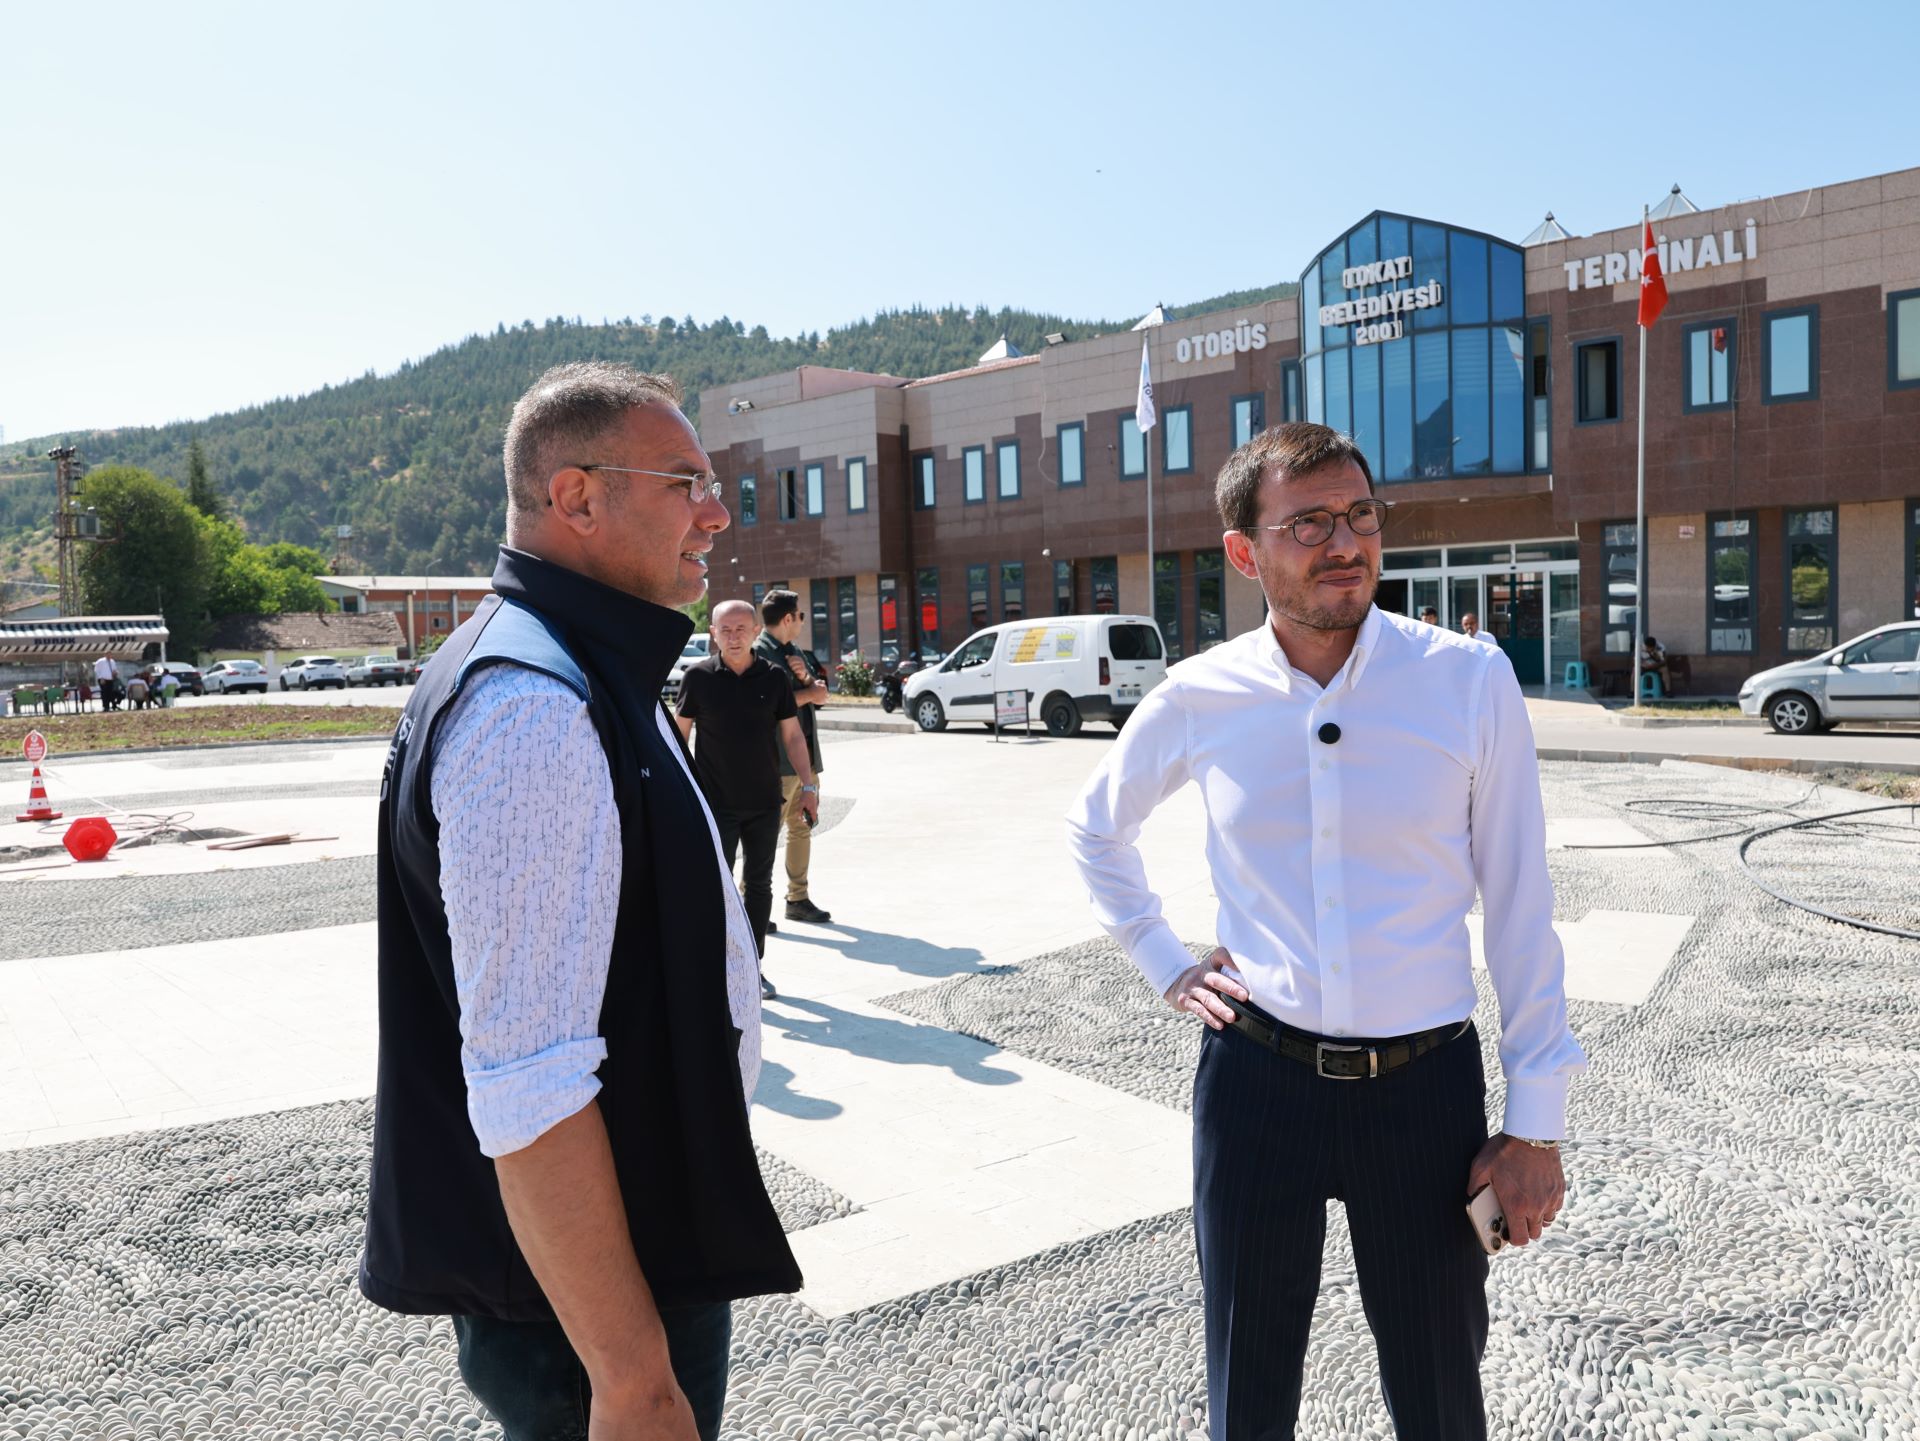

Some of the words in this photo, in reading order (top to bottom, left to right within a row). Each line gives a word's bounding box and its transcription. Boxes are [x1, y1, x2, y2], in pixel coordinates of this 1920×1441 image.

[1343, 256, 1412, 289] TOKAT
[1320, 279, 1441, 327] BELEDİYESİ
[1176, 318, 1268, 363] OTOBÜS
[1355, 320, 1403, 346] 2001
